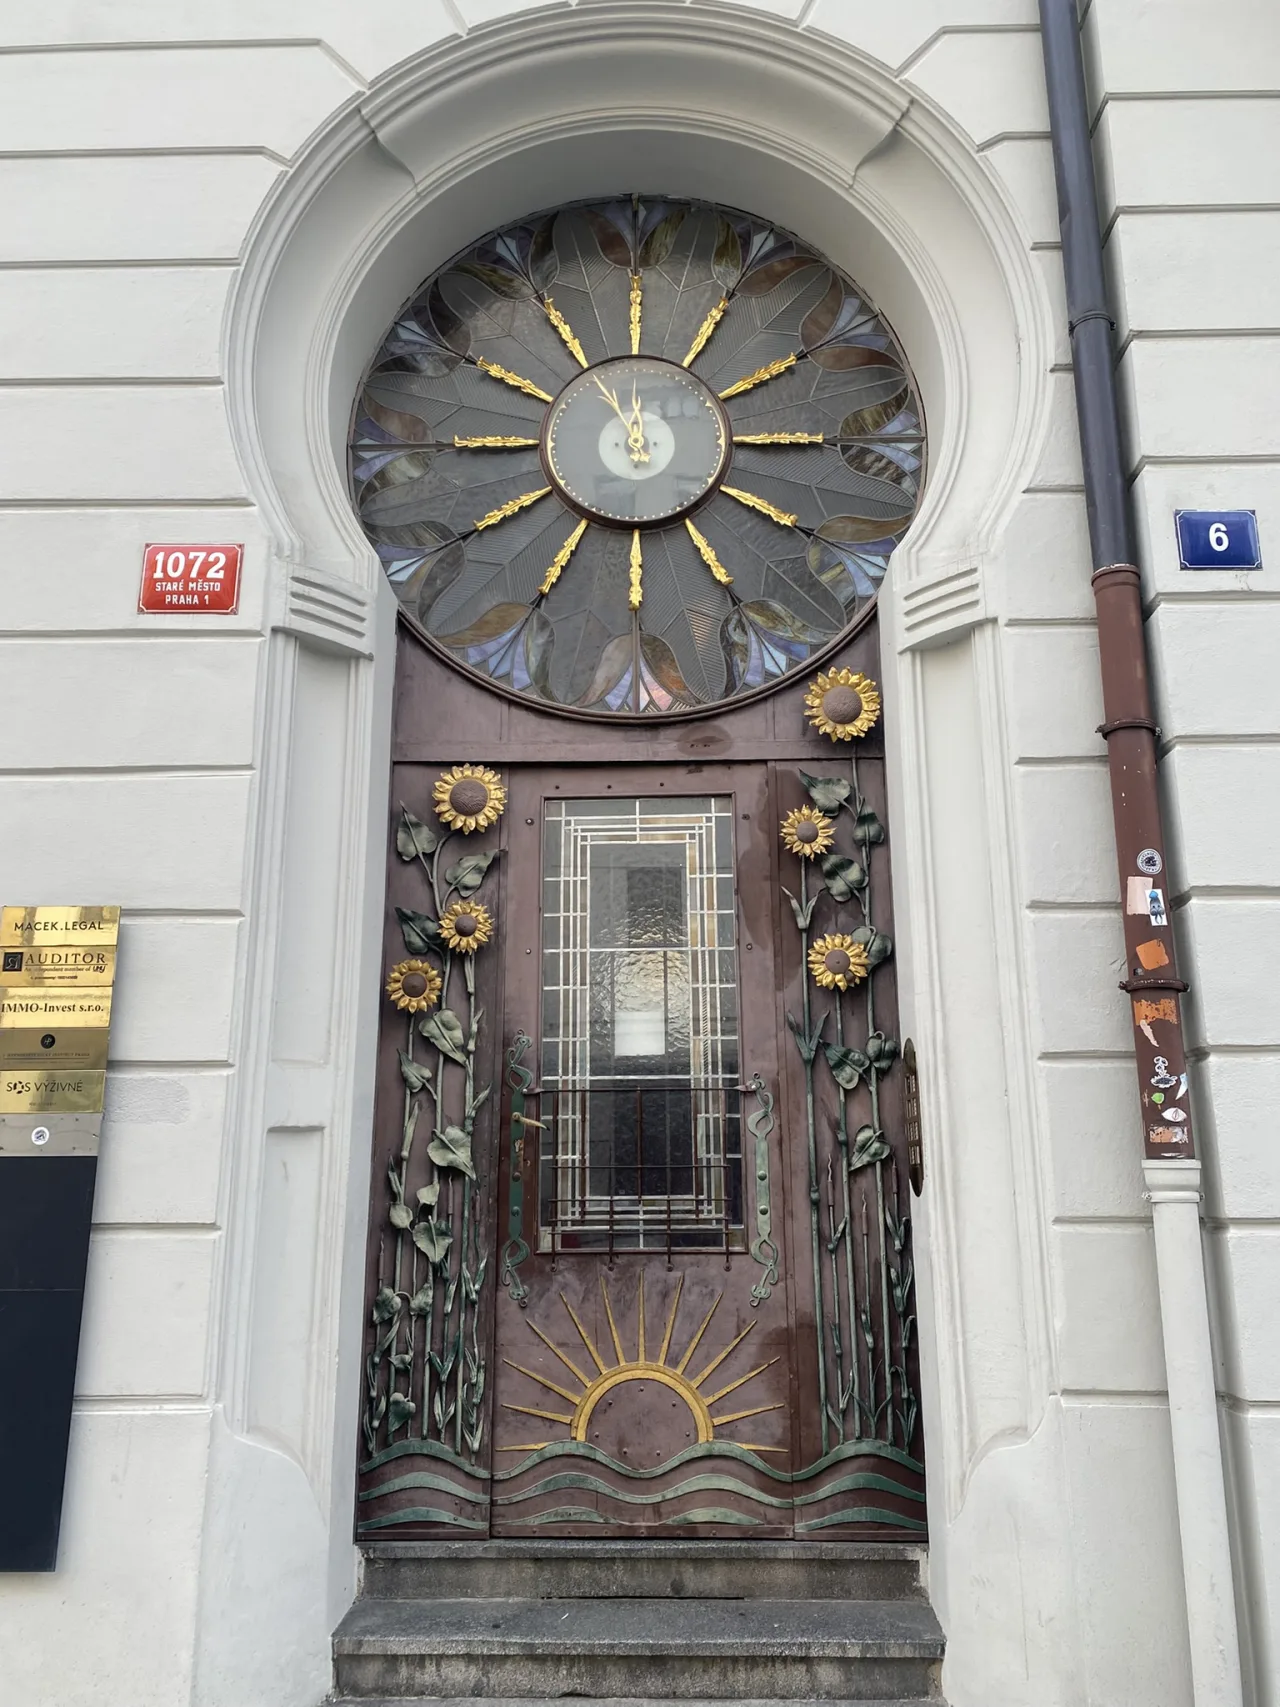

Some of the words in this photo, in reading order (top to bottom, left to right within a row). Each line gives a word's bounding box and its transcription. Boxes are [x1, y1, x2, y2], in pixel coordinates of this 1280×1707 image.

[1208, 522, 1229, 552] 6
[152, 551, 226, 579] 1072
[155, 579, 184, 591] STARÉ
[188, 579, 221, 591] MĚSTO
[165, 594, 199, 605] PRAHA
[204, 595, 209, 605] 1
[14, 921, 104, 931] MACEK.LEGAL
[25, 953, 106, 964] AUDITOR
[1, 1003, 76, 1013] IMMO-Invest
[79, 1003, 104, 1012] s.r.o.
[34, 1079, 83, 1092] VÝŽIVNÉ
